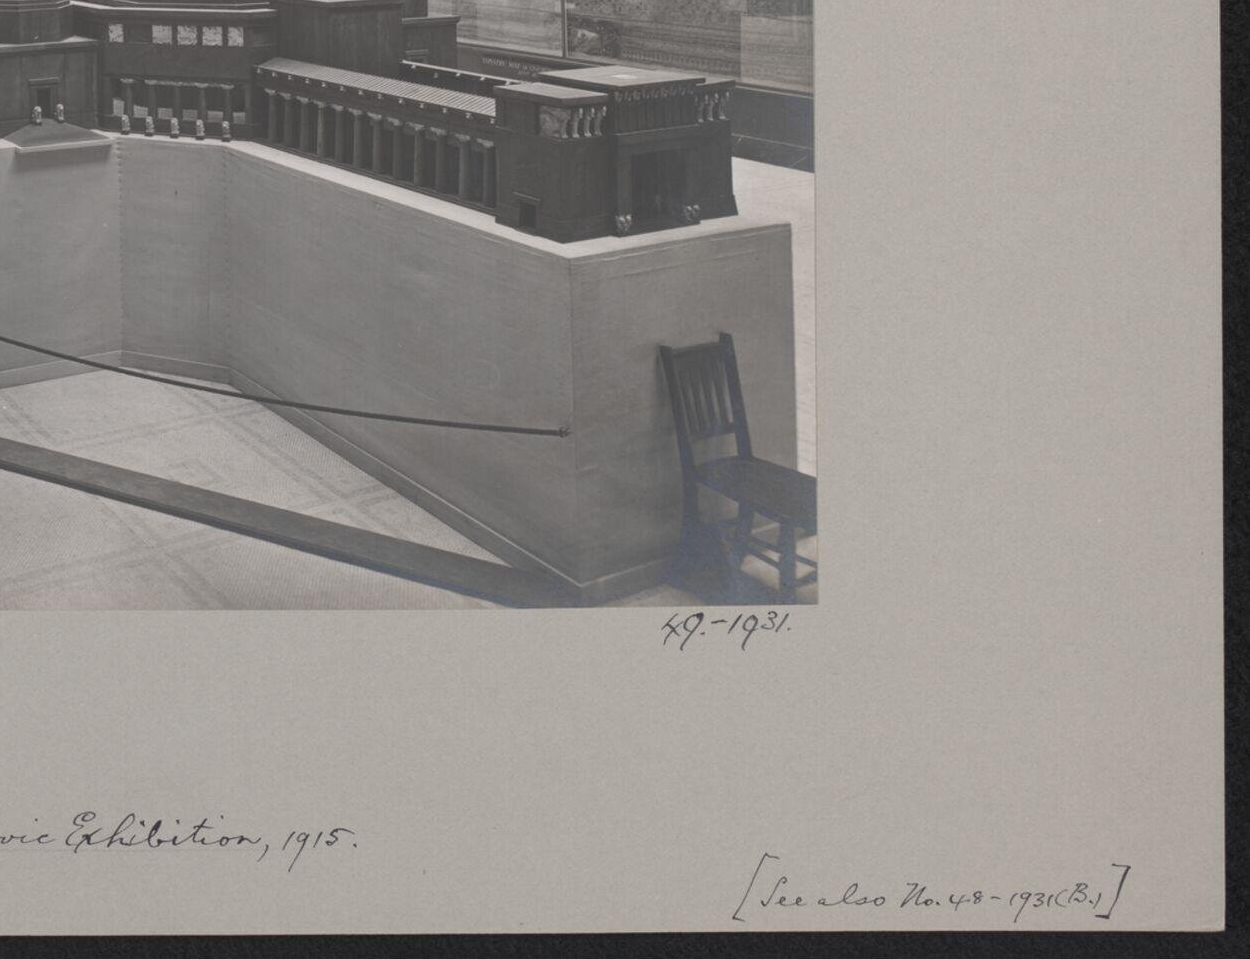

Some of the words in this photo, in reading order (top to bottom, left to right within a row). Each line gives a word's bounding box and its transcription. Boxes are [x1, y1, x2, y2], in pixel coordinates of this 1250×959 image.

[64, 810, 270, 863] Exhibition,
[281, 827, 358, 873] 1915.
[817, 882, 886, 907] also
